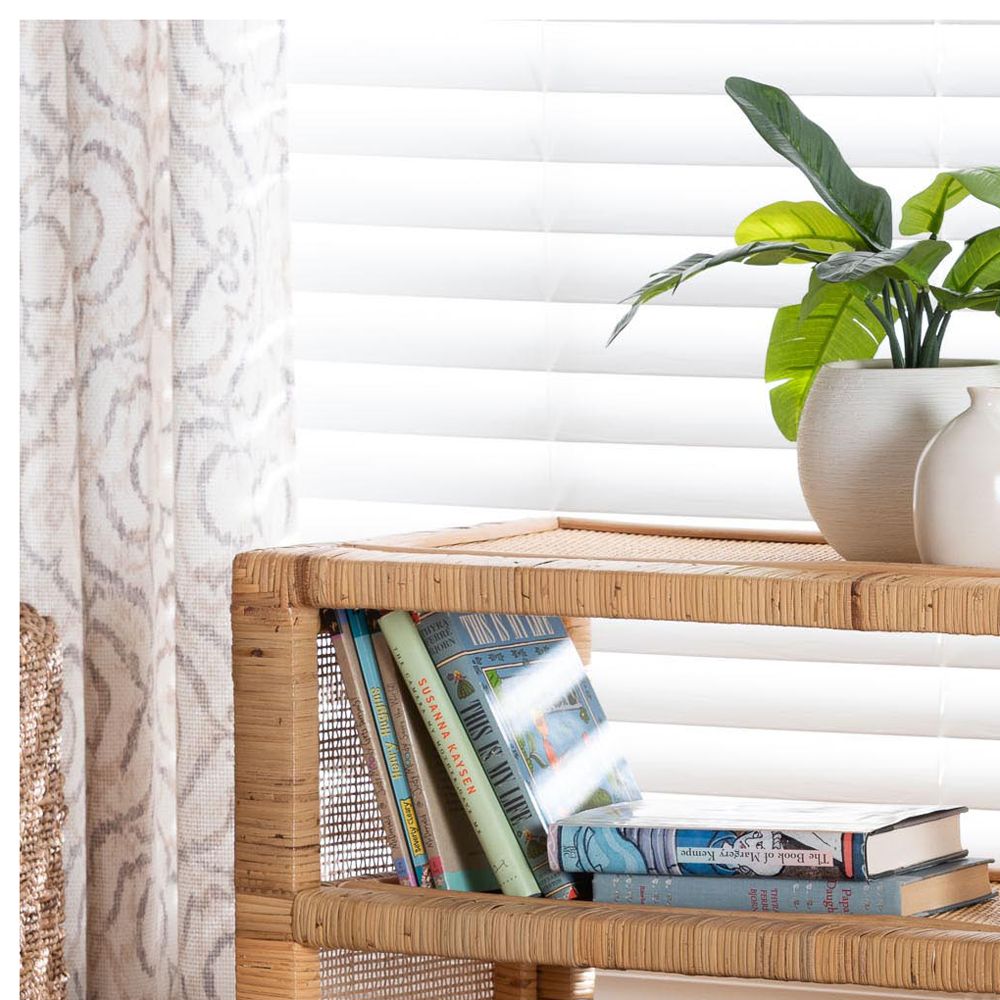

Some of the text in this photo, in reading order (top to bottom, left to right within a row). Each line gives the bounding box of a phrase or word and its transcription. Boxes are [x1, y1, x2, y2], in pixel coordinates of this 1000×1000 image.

[460, 613, 496, 645] THIS
[490, 613, 510, 641] IS
[525, 614, 555, 637] LIFE
[369, 686, 405, 781] Henry Huggins
[418, 678, 477, 795] SUSANNA KAYSEN
[461, 699, 533, 827] THIS IS MY LIFE
[680, 849, 830, 866] The Book of Margery Kempe
